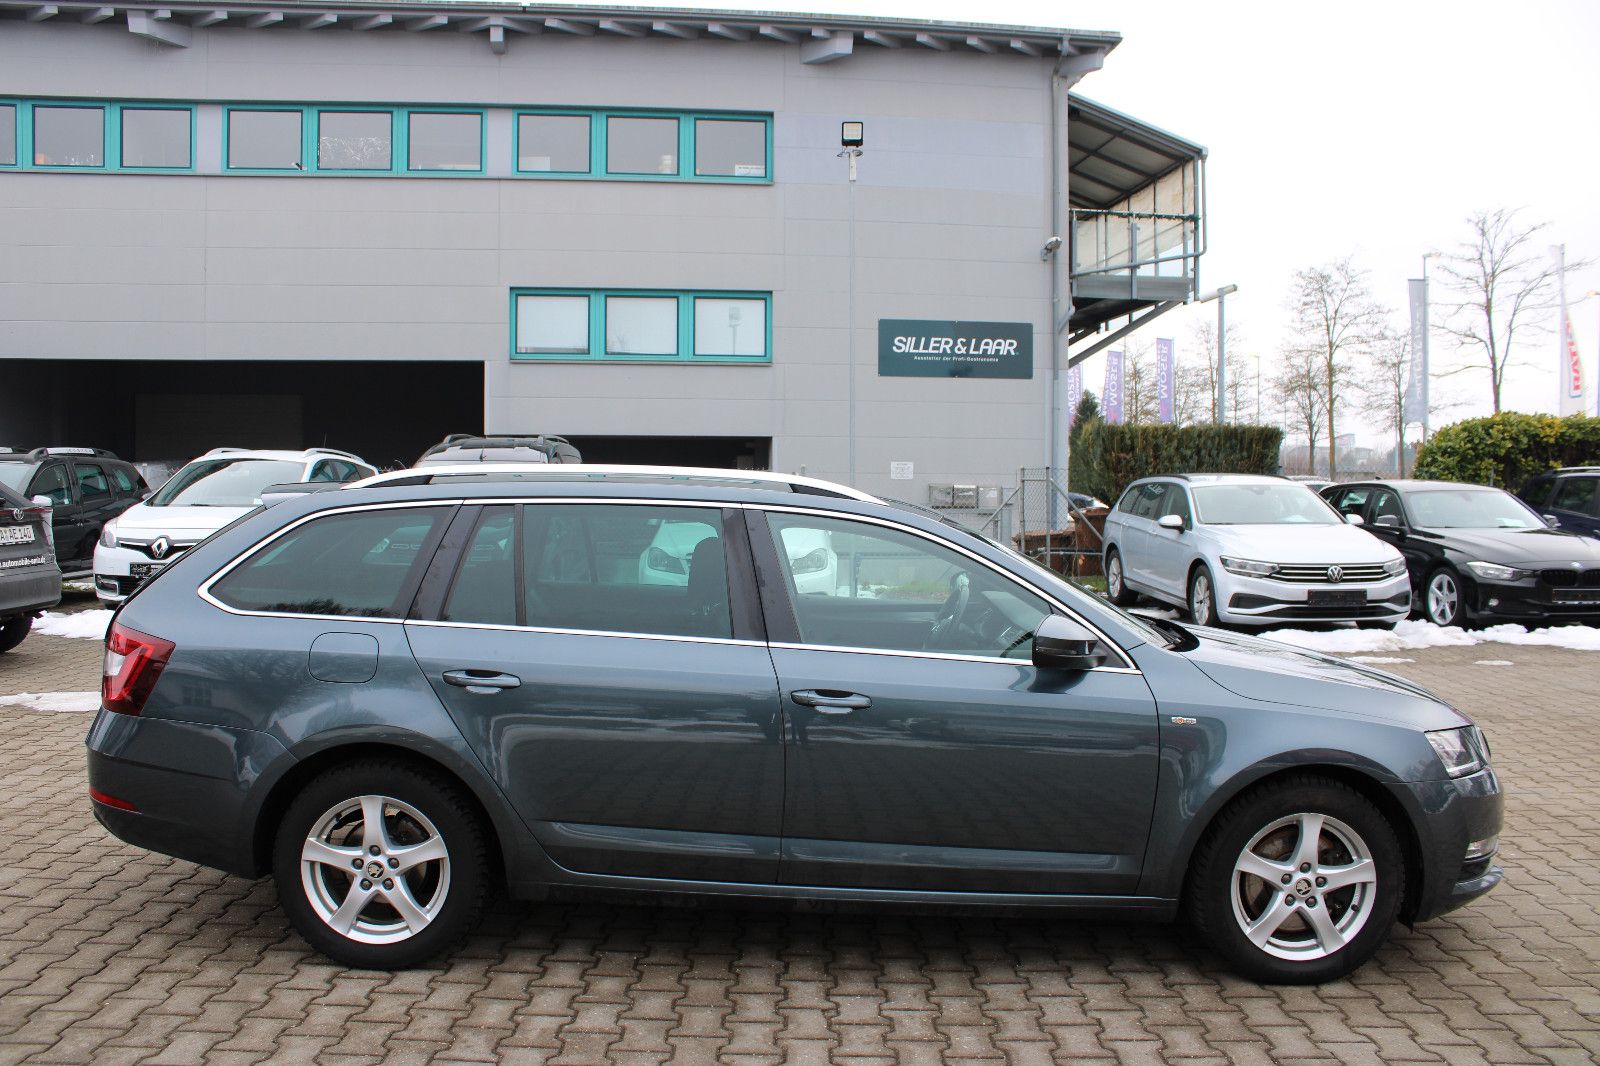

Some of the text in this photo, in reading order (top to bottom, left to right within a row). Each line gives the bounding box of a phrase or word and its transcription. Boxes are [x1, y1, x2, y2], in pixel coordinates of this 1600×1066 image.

[892, 336, 1018, 356] SILLER & LAAR
